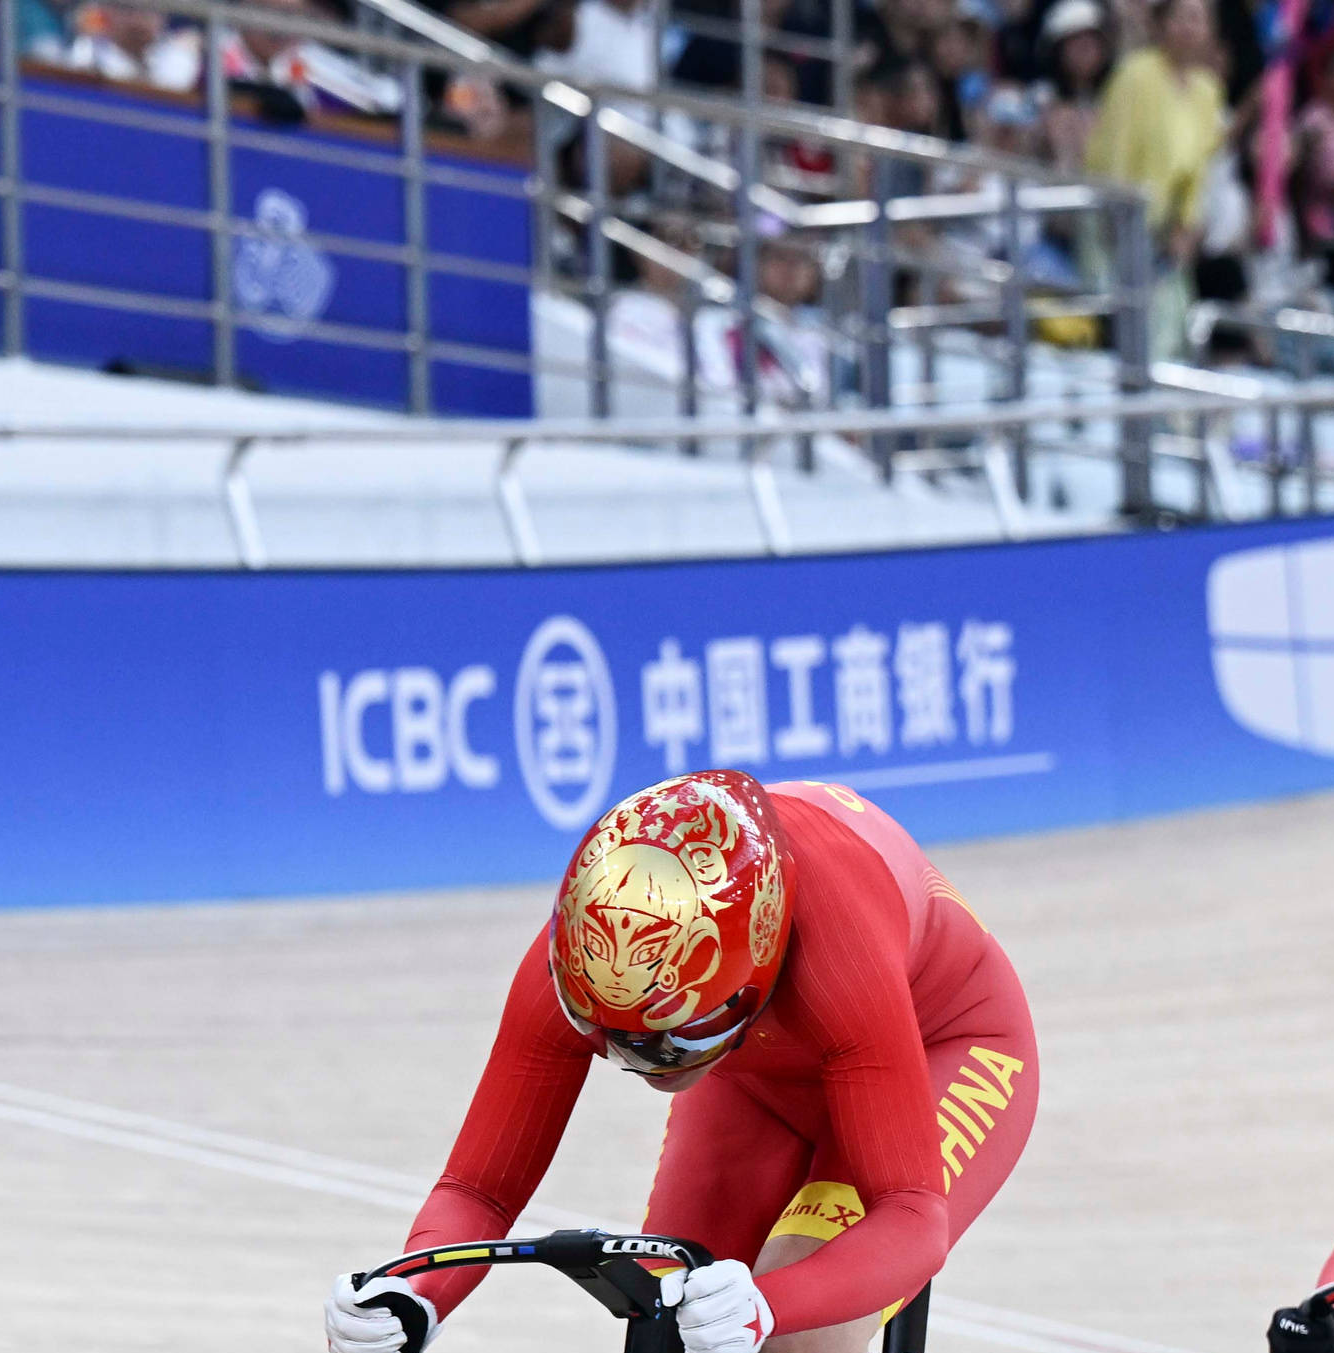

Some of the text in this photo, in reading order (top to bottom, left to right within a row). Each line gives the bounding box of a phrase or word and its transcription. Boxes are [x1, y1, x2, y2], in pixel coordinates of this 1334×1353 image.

[319, 666, 501, 796] ICBC
[641, 620, 1017, 770] 中国工商银行
[943, 1046, 1024, 1195] HINA
[602, 1240, 683, 1260] LOOK
